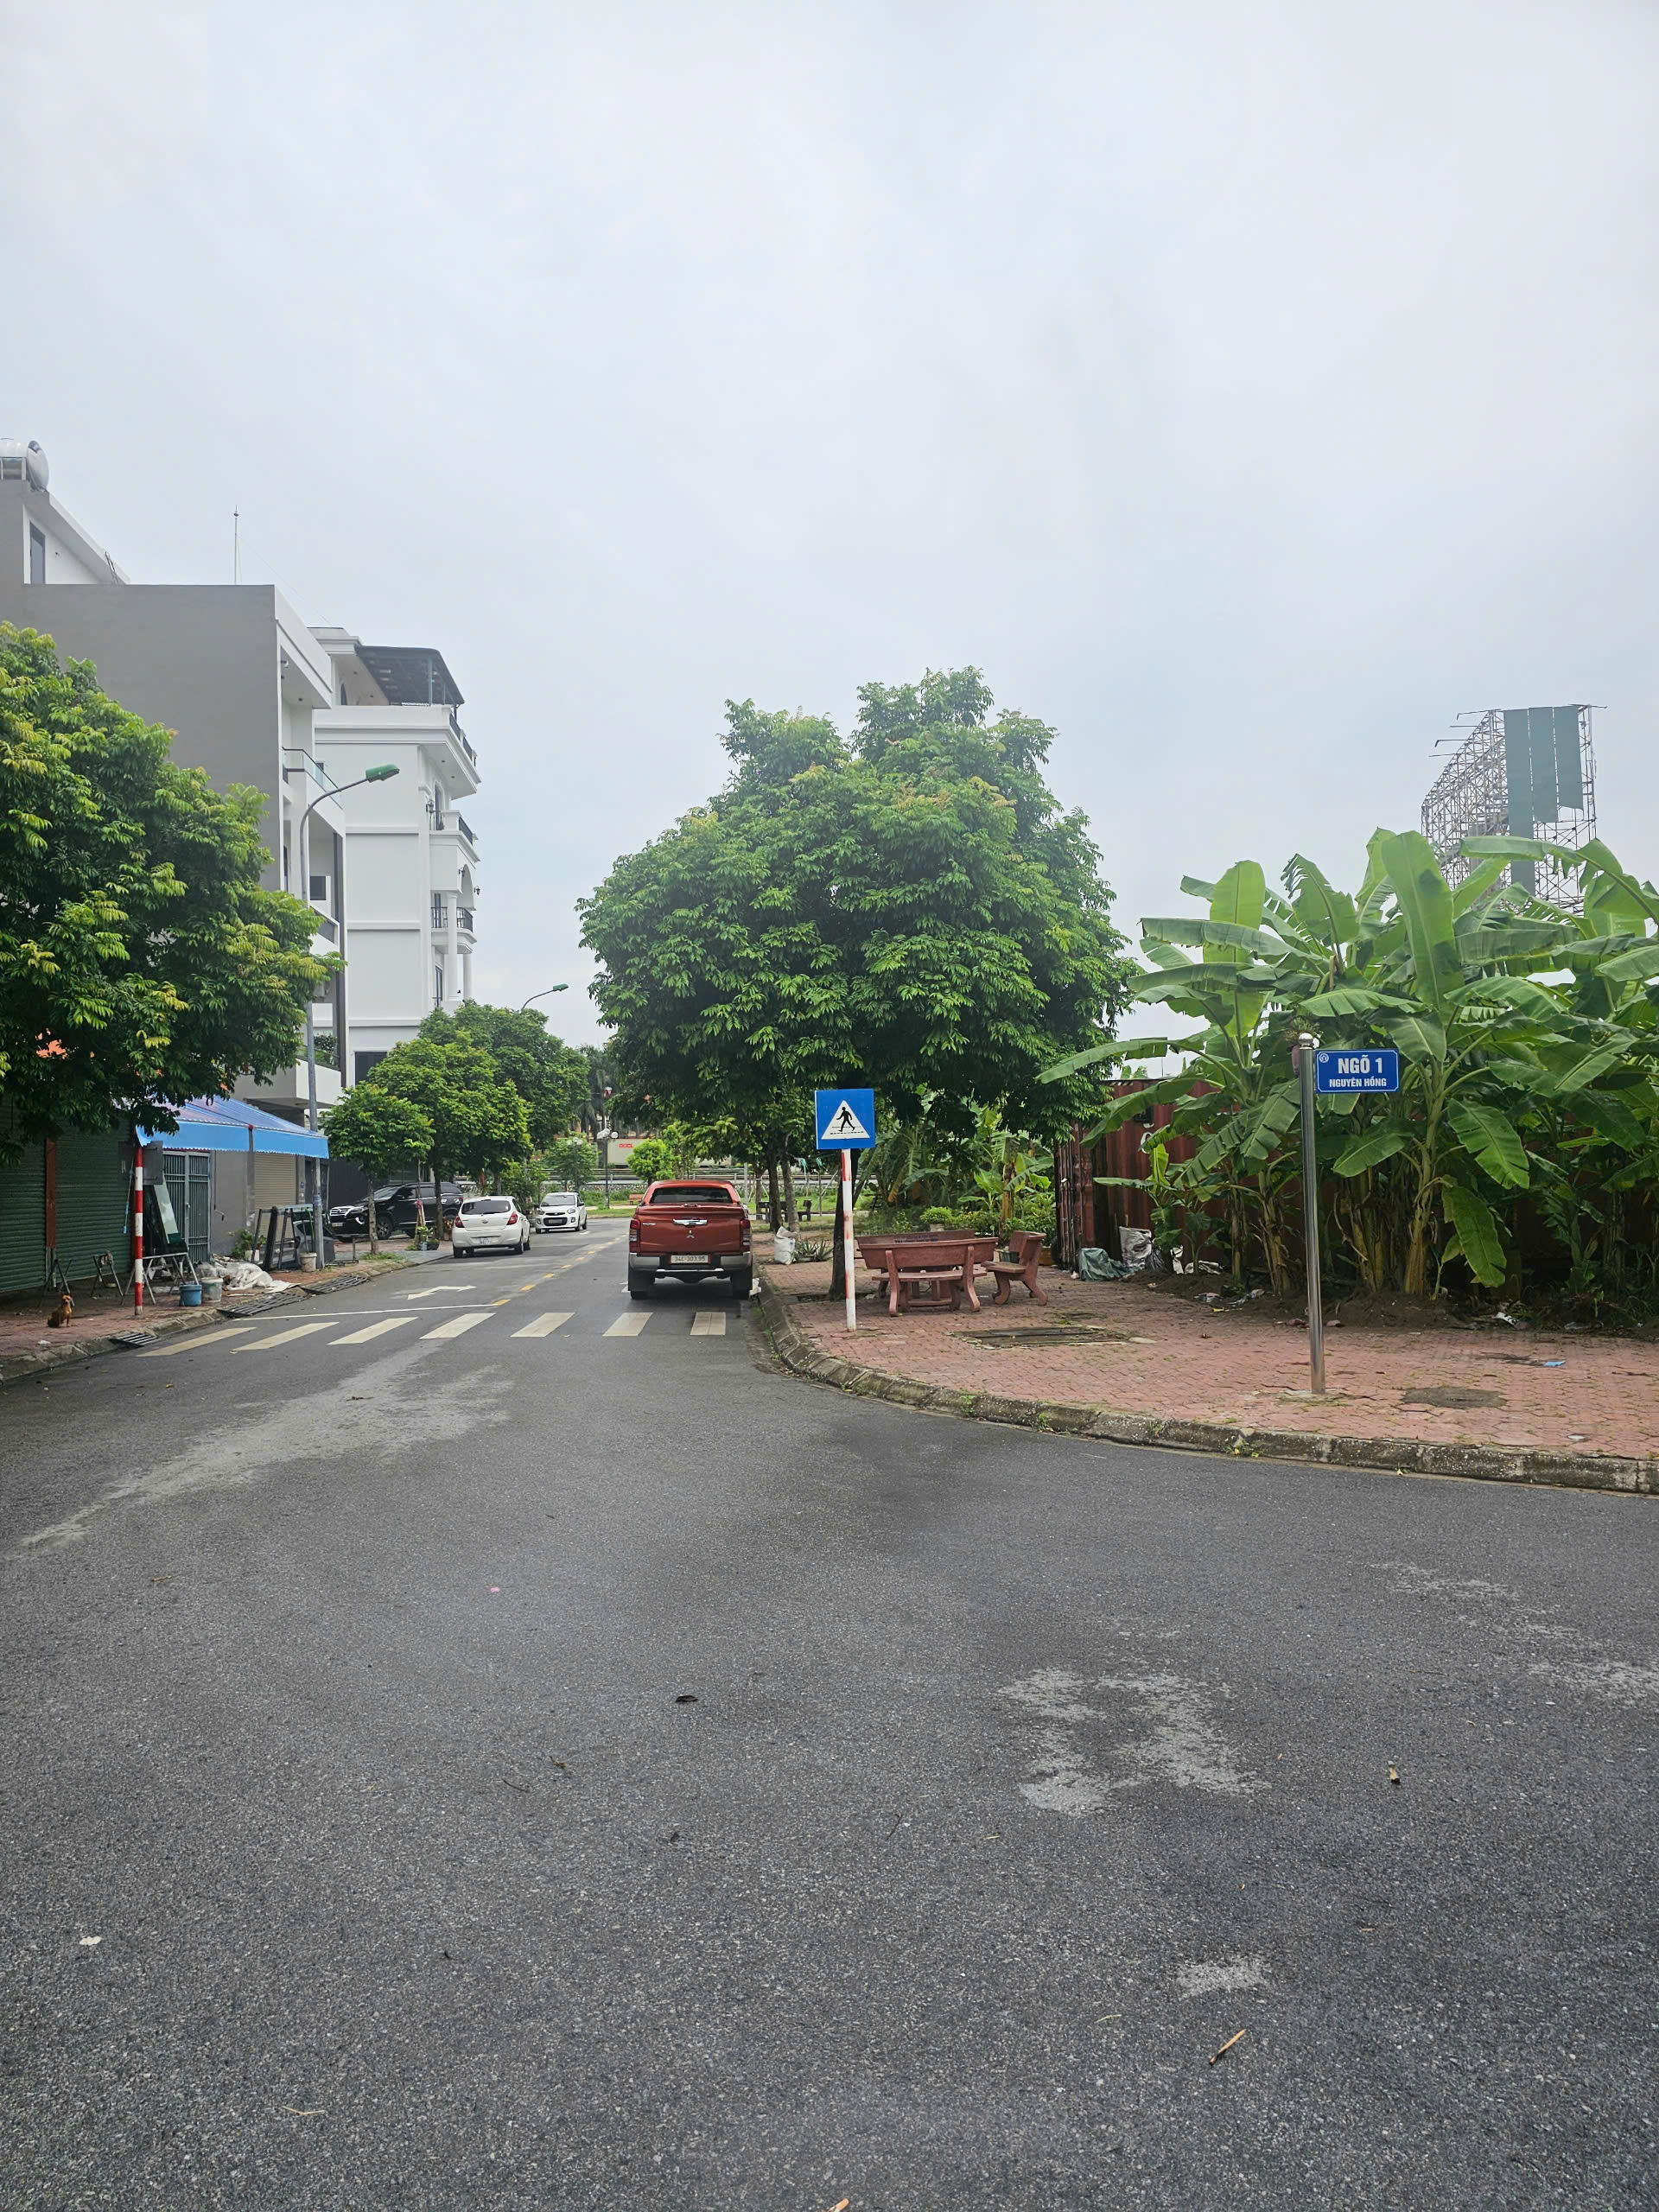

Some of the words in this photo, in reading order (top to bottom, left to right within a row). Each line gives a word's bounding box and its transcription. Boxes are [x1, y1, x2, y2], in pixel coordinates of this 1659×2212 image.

[1338, 1054, 1370, 1074] NGÕ
[1375, 1058, 1382, 1073] 1
[1329, 1077, 1362, 1088] NGUYÊN
